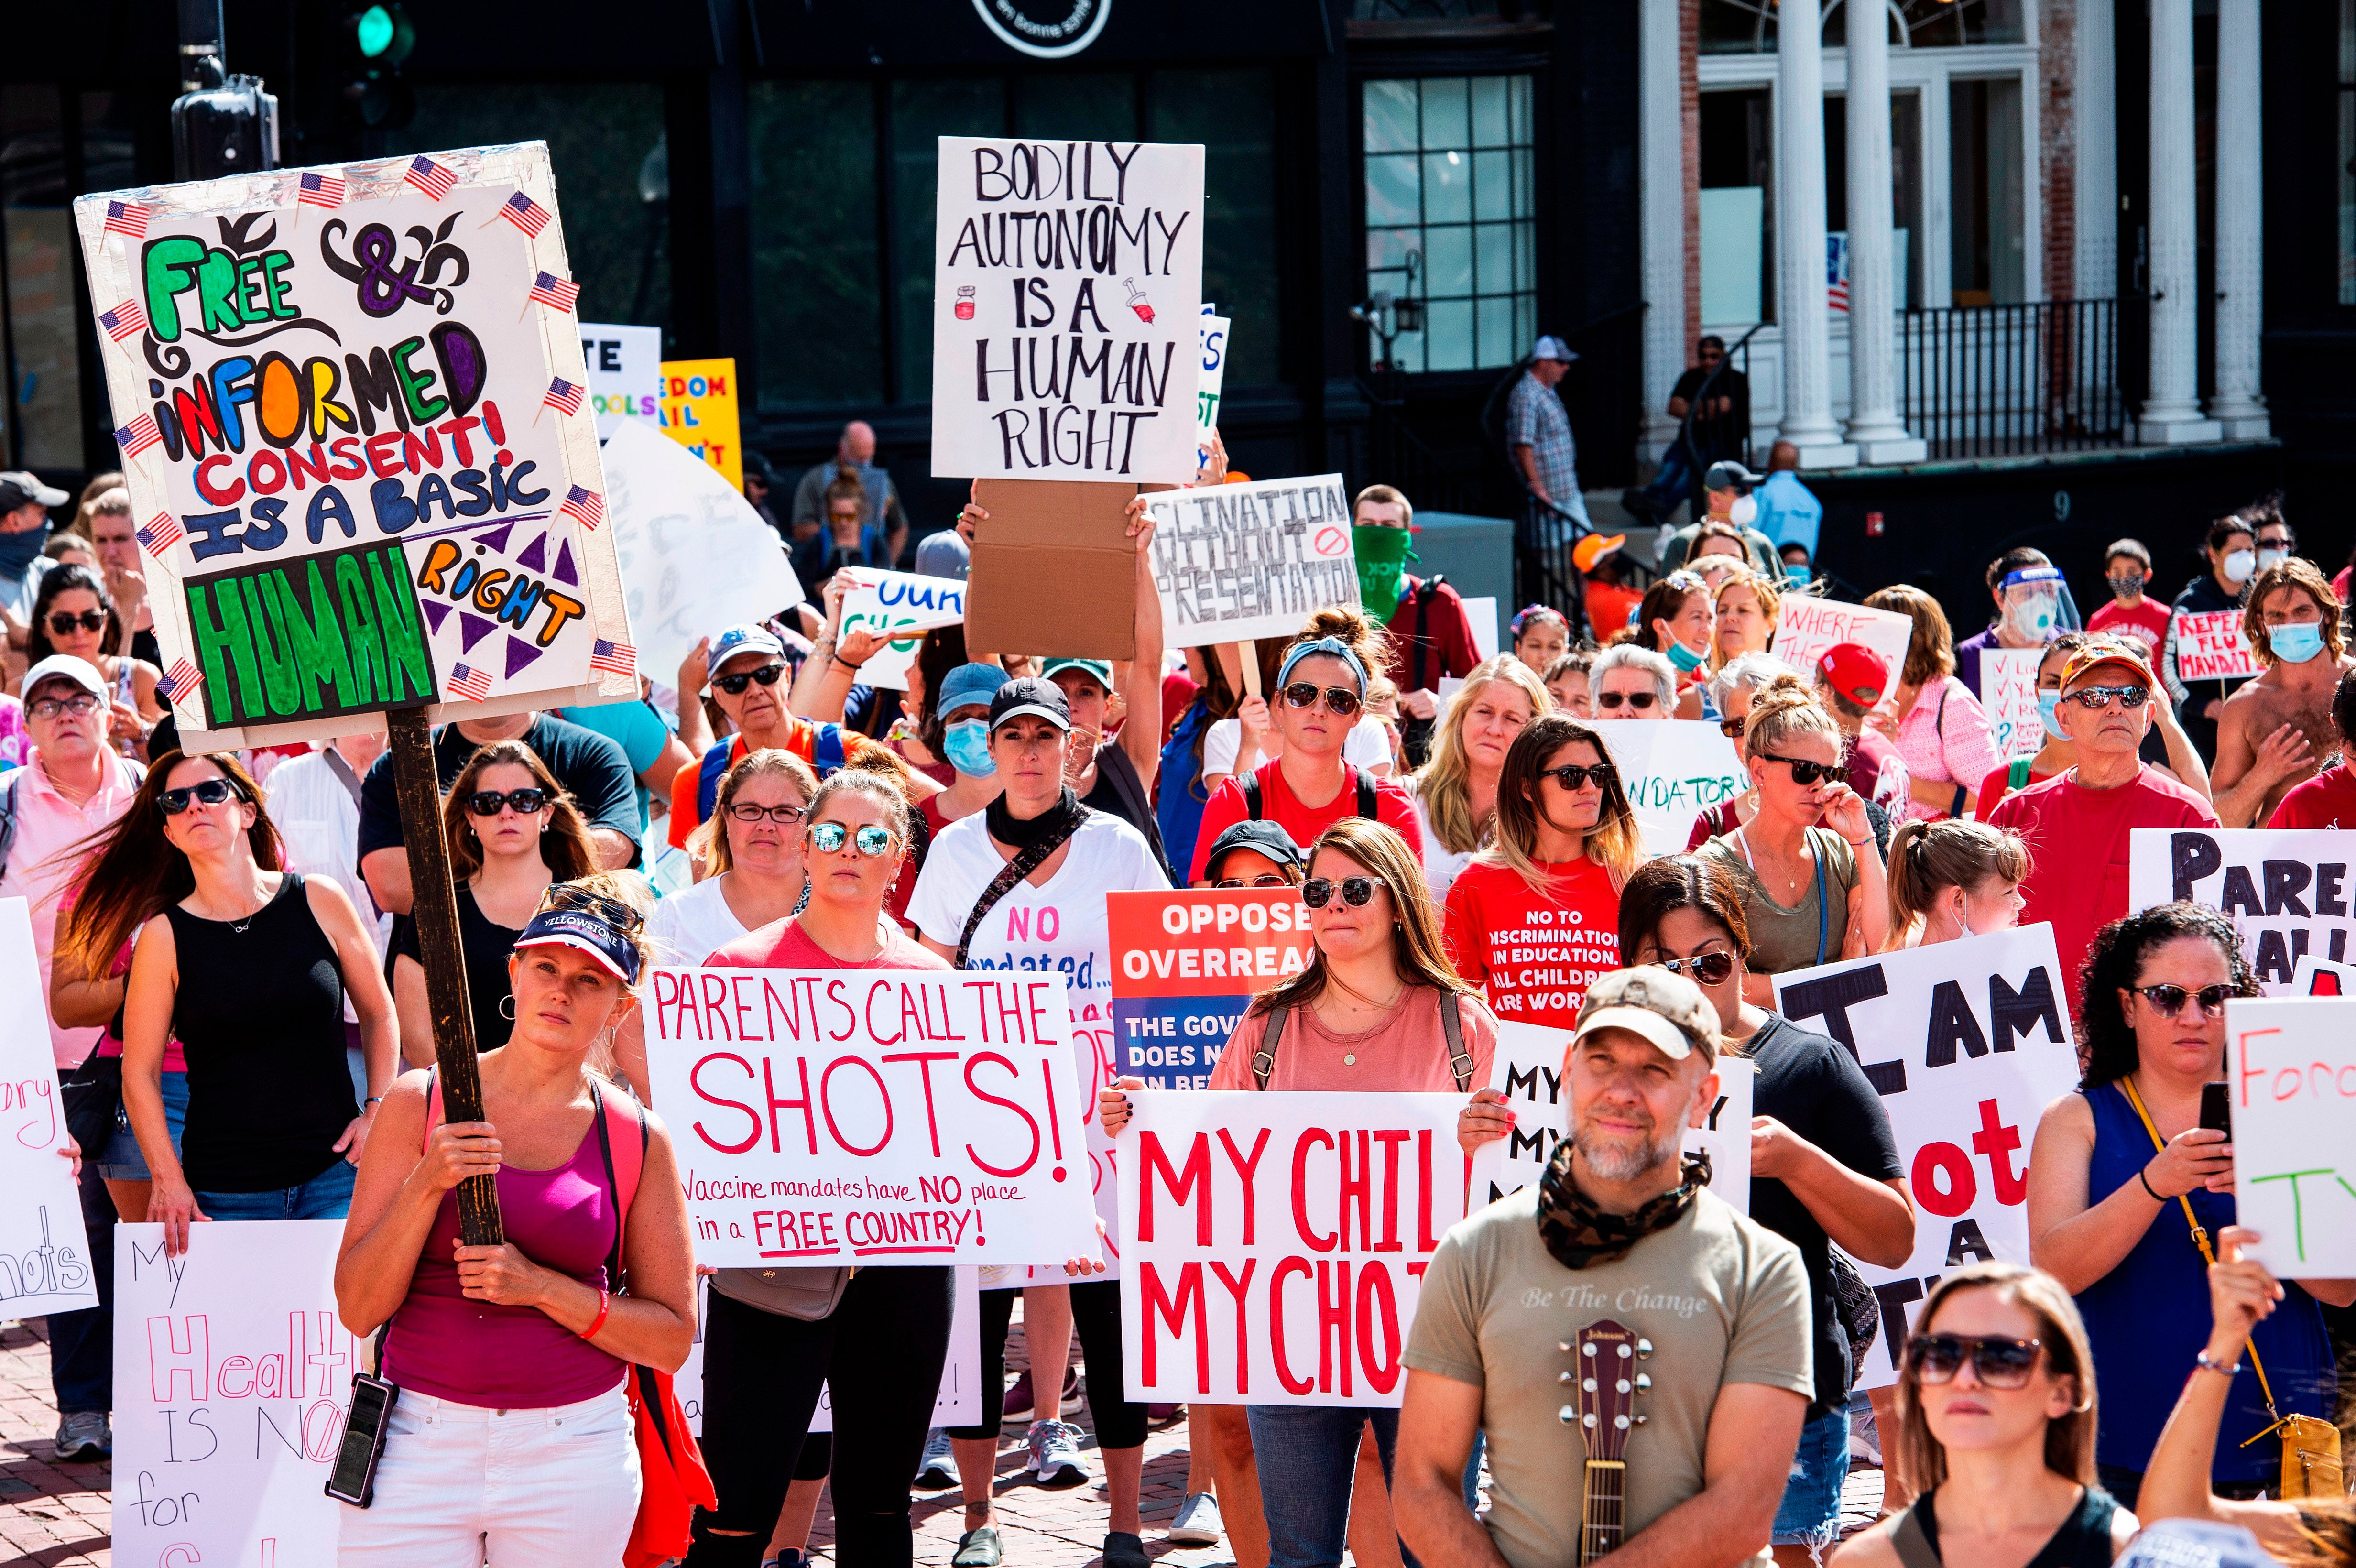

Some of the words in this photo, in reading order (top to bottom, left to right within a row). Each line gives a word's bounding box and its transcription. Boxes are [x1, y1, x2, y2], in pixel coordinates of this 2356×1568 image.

[972, 142, 1142, 205] BODILY
[948, 205, 1190, 276] AUTONOMY
[142, 235, 301, 343] FREE
[353, 223, 436, 318] &
[1013, 277, 1055, 328] IS
[1069, 277, 1110, 333] A
[976, 335, 1175, 407] HUMAN
[194, 400, 513, 507] CONSENT!
[992, 405, 1158, 473] RIGHT
[182, 498, 288, 563] IS
[306, 484, 356, 544] A
[2054, 490, 2071, 522] 9
[1154, 518, 1307, 575] WITHOUT
[186, 546, 433, 724] HUMAN
[1786, 603, 1877, 643] WHERE
[2198, 635, 2238, 652] FLU
[1229, 833, 1251, 841] adidas
[2171, 832, 2356, 919] PARE
[544, 916, 618, 947] YELLOWSTONE
[1007, 906, 1059, 942] NO
[1162, 902, 1311, 935] OPPOSE
[1526, 911, 1553, 925] NO
[1558, 911, 1582, 925] TO
[1493, 950, 1507, 965] IN
[1512, 947, 1619, 966] EDUCATION.
[653, 971, 855, 1042] PARENTS
[866, 980, 966, 1046] CALL
[963, 981, 1057, 1045] THE
[1125, 1017, 1176, 1037] THE
[1494, 993, 1523, 1012] ARE
[1779, 963, 1907, 1095] I
[1926, 966, 2066, 1068] AM
[1128, 1045, 1196, 1067] DOES
[690, 1051, 1067, 1183] SHOTS!
[681, 1169, 767, 1202] Vaccine
[771, 1177, 862, 1198] mandates
[868, 1176, 916, 1201] have
[919, 1175, 962, 1205] NO
[971, 1181, 1026, 1205] place
[1138, 1127, 1272, 1247] MY
[1291, 1126, 1472, 1252] CHIL
[696, 1215, 718, 1241] in
[729, 1221, 746, 1239] a
[754, 1209, 838, 1249] FREE
[845, 1208, 986, 1247] COUNTRY!
[1945, 1218, 1995, 1267] A
[133, 1241, 185, 1308] My
[1520, 1286, 1552, 1309] Be
[1560, 1284, 1608, 1309] The
[1616, 1285, 1709, 1319] Change
[1139, 1257, 1257, 1395] MY
[1585, 1329, 1626, 1341] Johnson
[159, 1408, 218, 1462] IS
[130, 1470, 200, 1526] for
